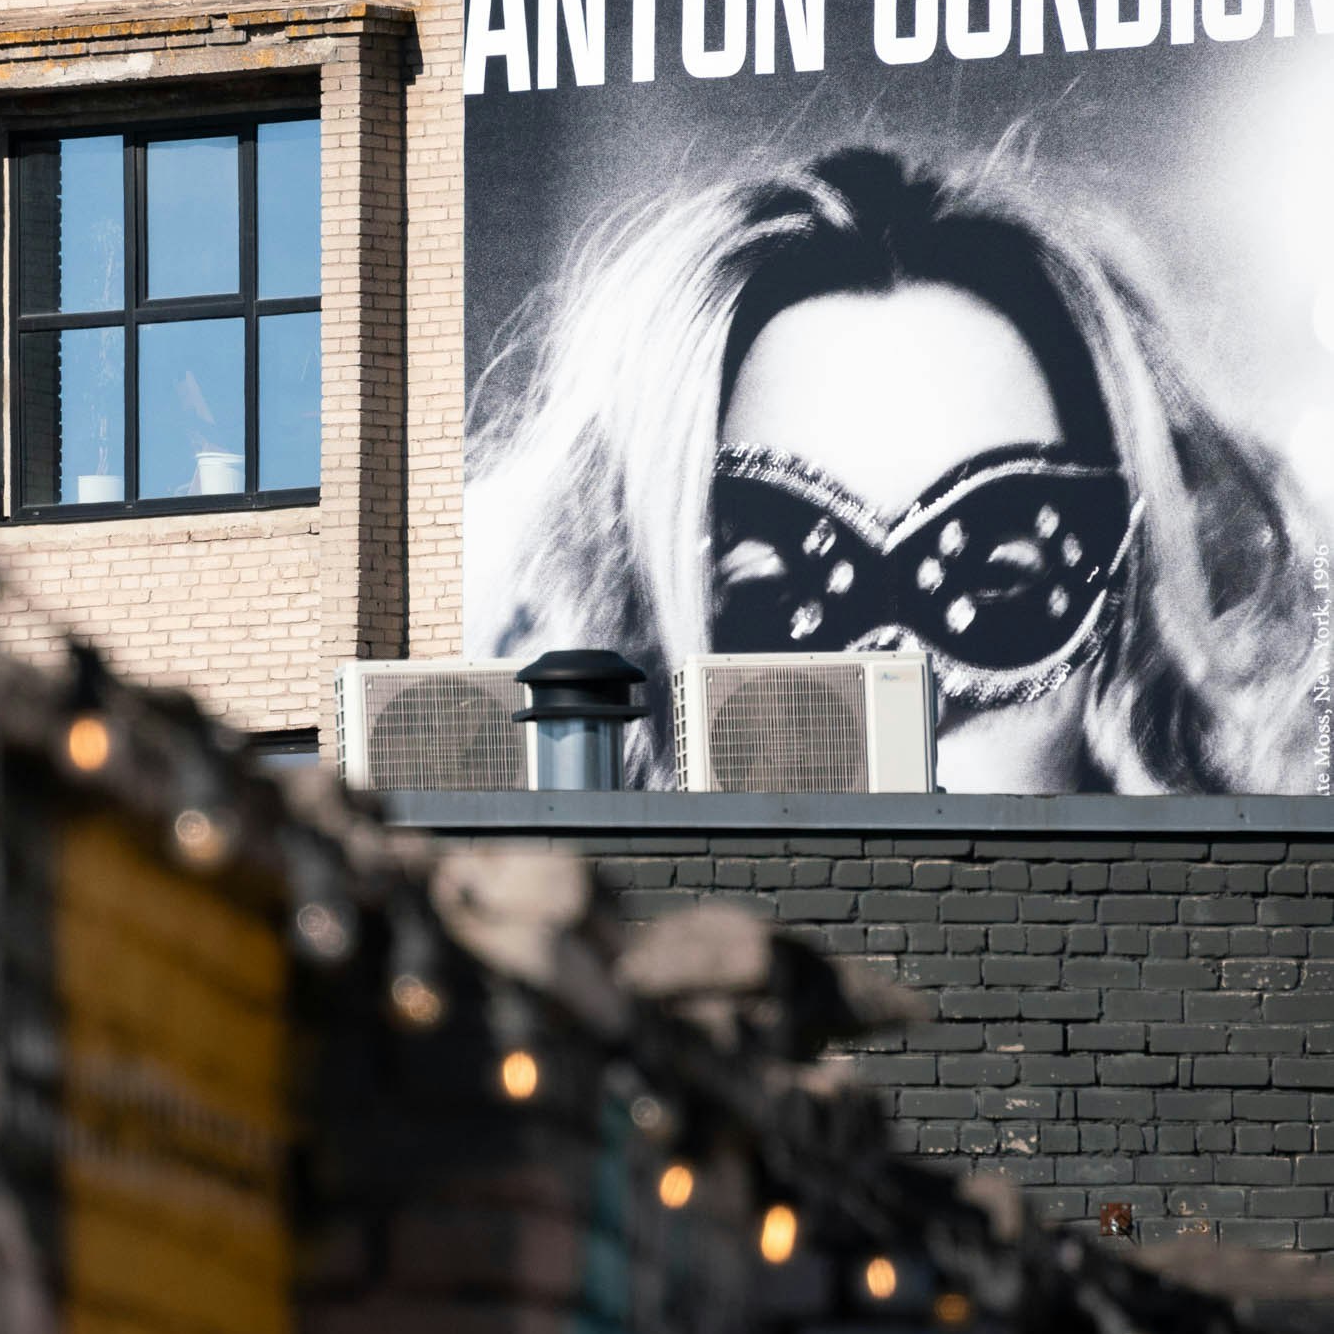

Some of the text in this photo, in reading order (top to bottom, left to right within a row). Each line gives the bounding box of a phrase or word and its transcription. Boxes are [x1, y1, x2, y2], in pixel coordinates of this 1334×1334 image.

[1312, 545, 1333, 796] te Moss, New York, 1996
